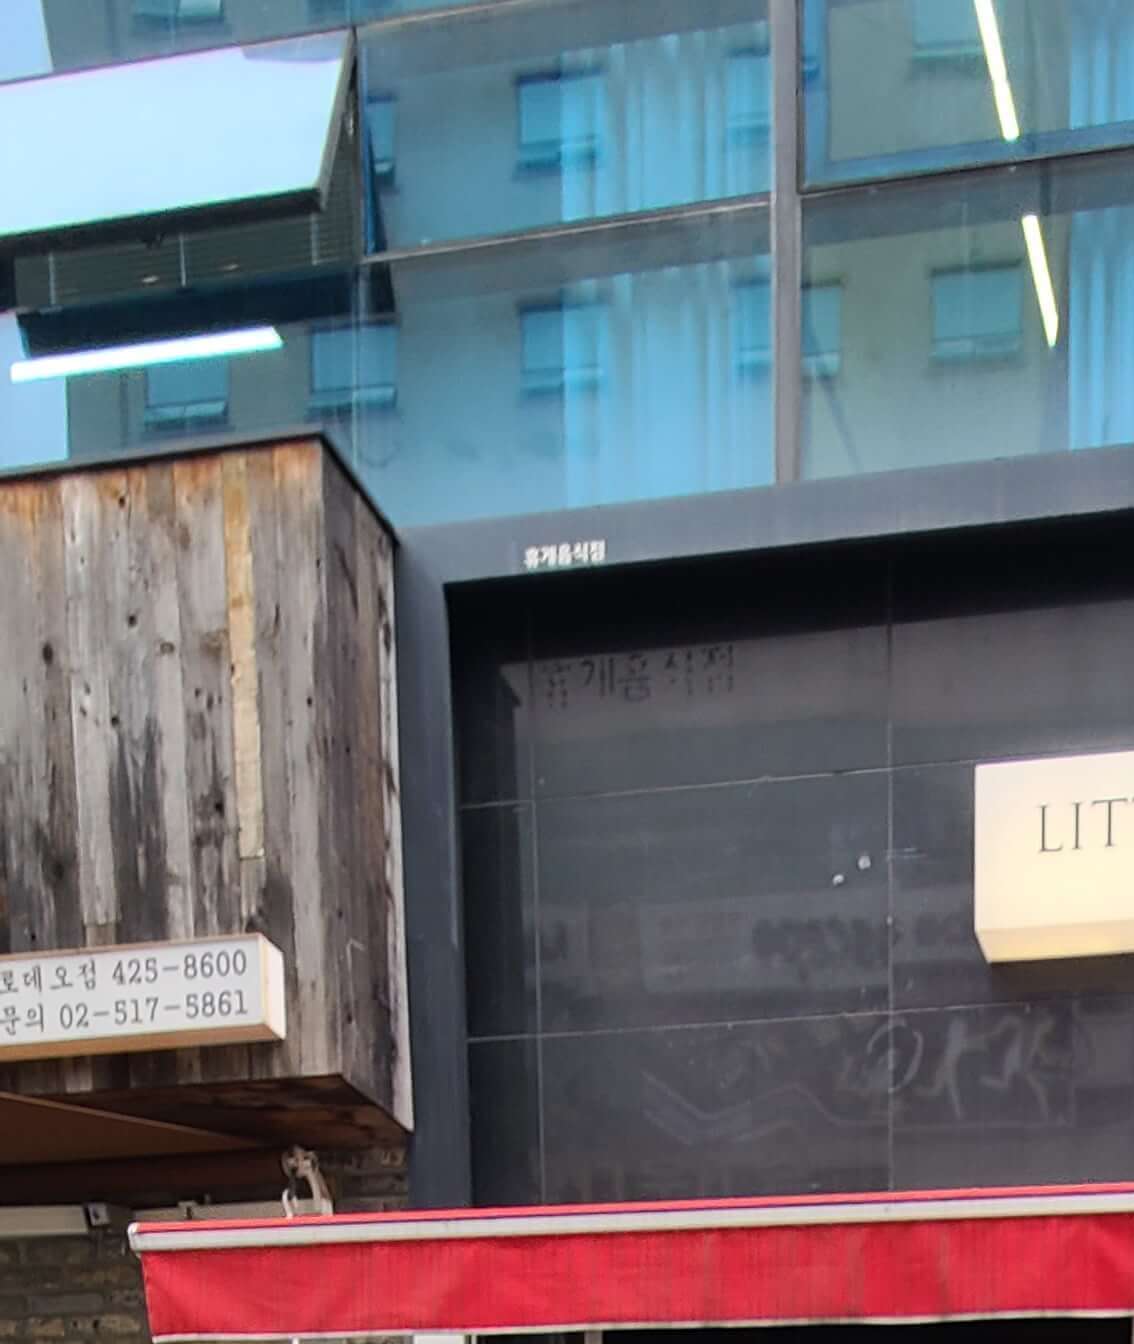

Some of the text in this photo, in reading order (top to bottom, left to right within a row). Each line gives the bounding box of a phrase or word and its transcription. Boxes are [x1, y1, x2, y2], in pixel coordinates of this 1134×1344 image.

[112, 949, 248, 985] 425-8600
[0, 989, 249, 1036] 문의 02-517-5861
